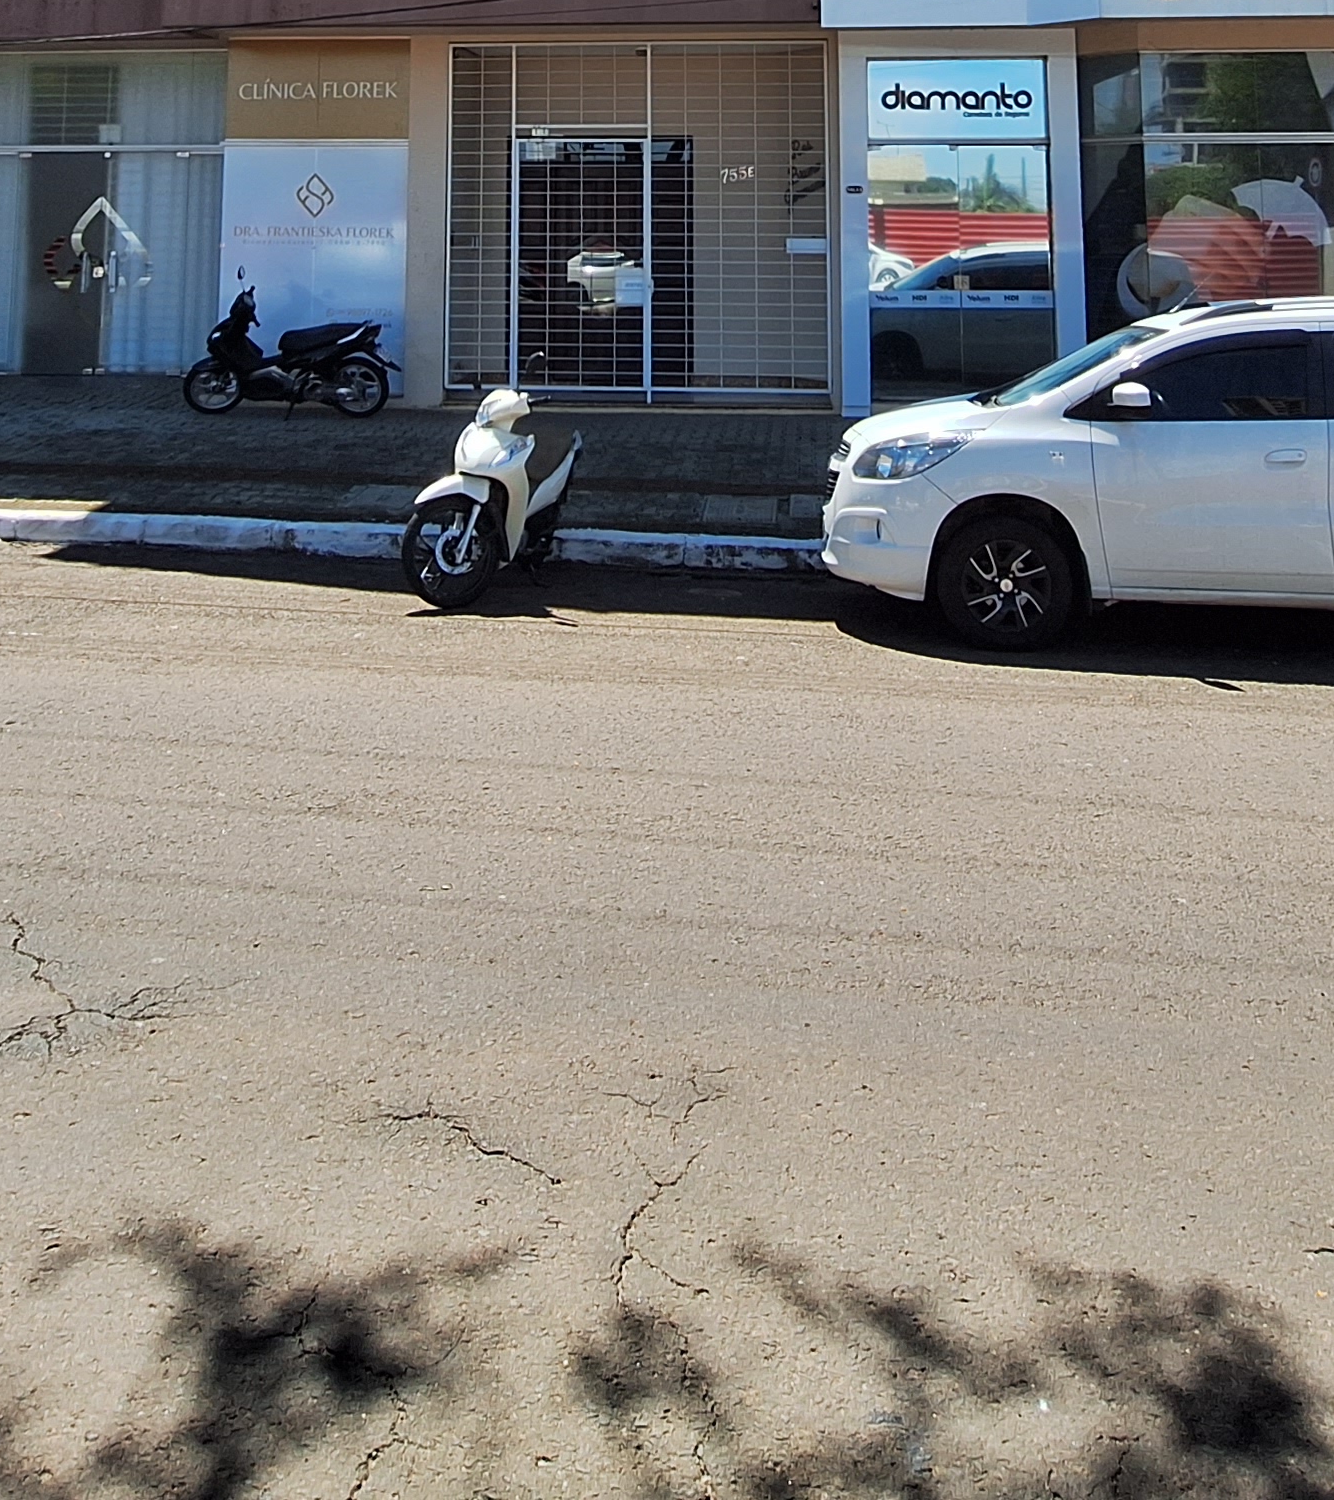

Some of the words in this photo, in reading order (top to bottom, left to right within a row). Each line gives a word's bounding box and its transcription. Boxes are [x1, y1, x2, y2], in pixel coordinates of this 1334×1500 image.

[238, 78, 316, 100] CLÍNICA
[322, 81, 397, 99] FLOREK
[881, 82, 1032, 111] diamanto
[346, 226, 395, 239] FLOREK
